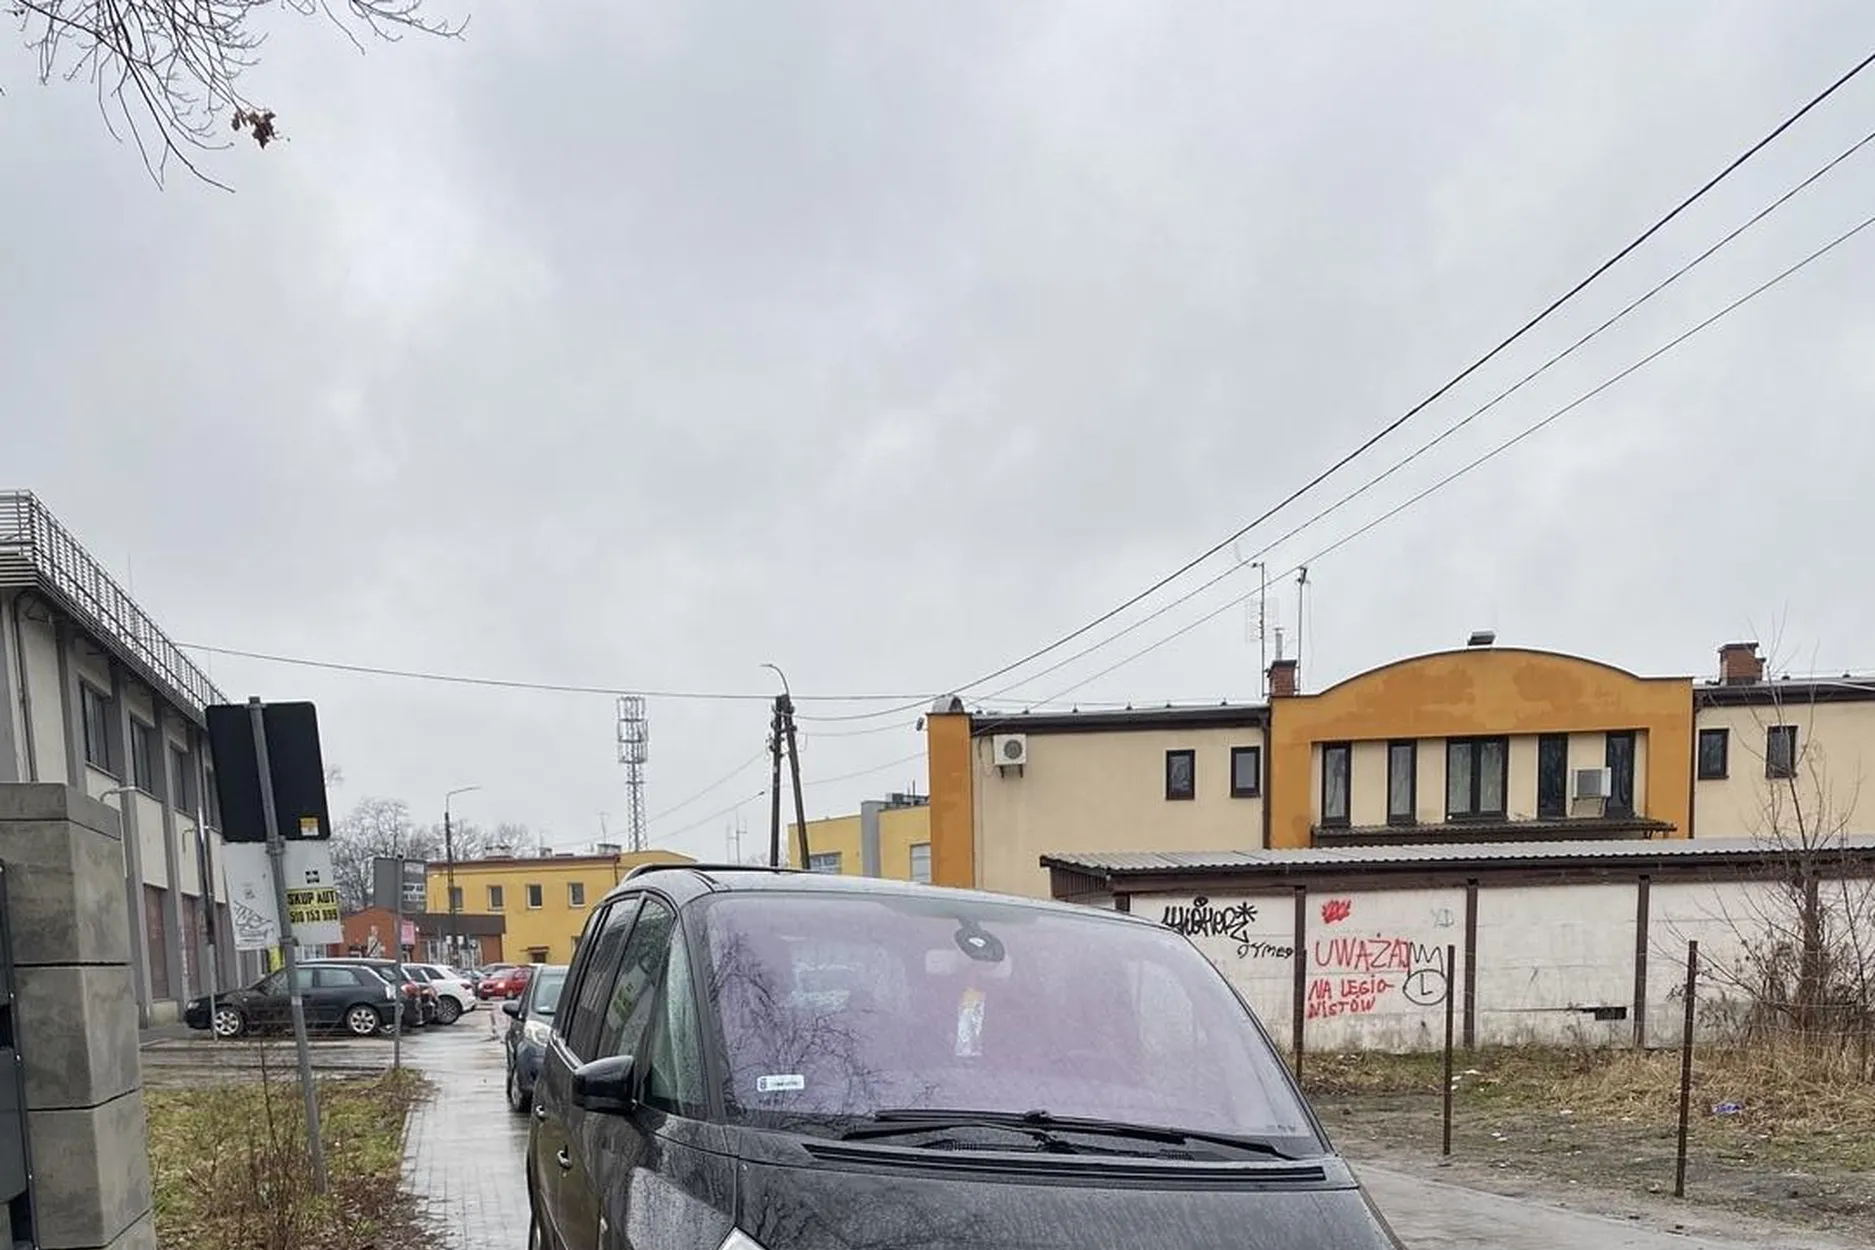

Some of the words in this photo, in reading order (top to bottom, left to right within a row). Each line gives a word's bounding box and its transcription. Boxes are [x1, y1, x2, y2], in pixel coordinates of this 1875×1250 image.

[287, 892, 314, 905] SKUP
[1315, 932, 1409, 972] UWAŻAJ
[1308, 978, 1332, 1001] NA
